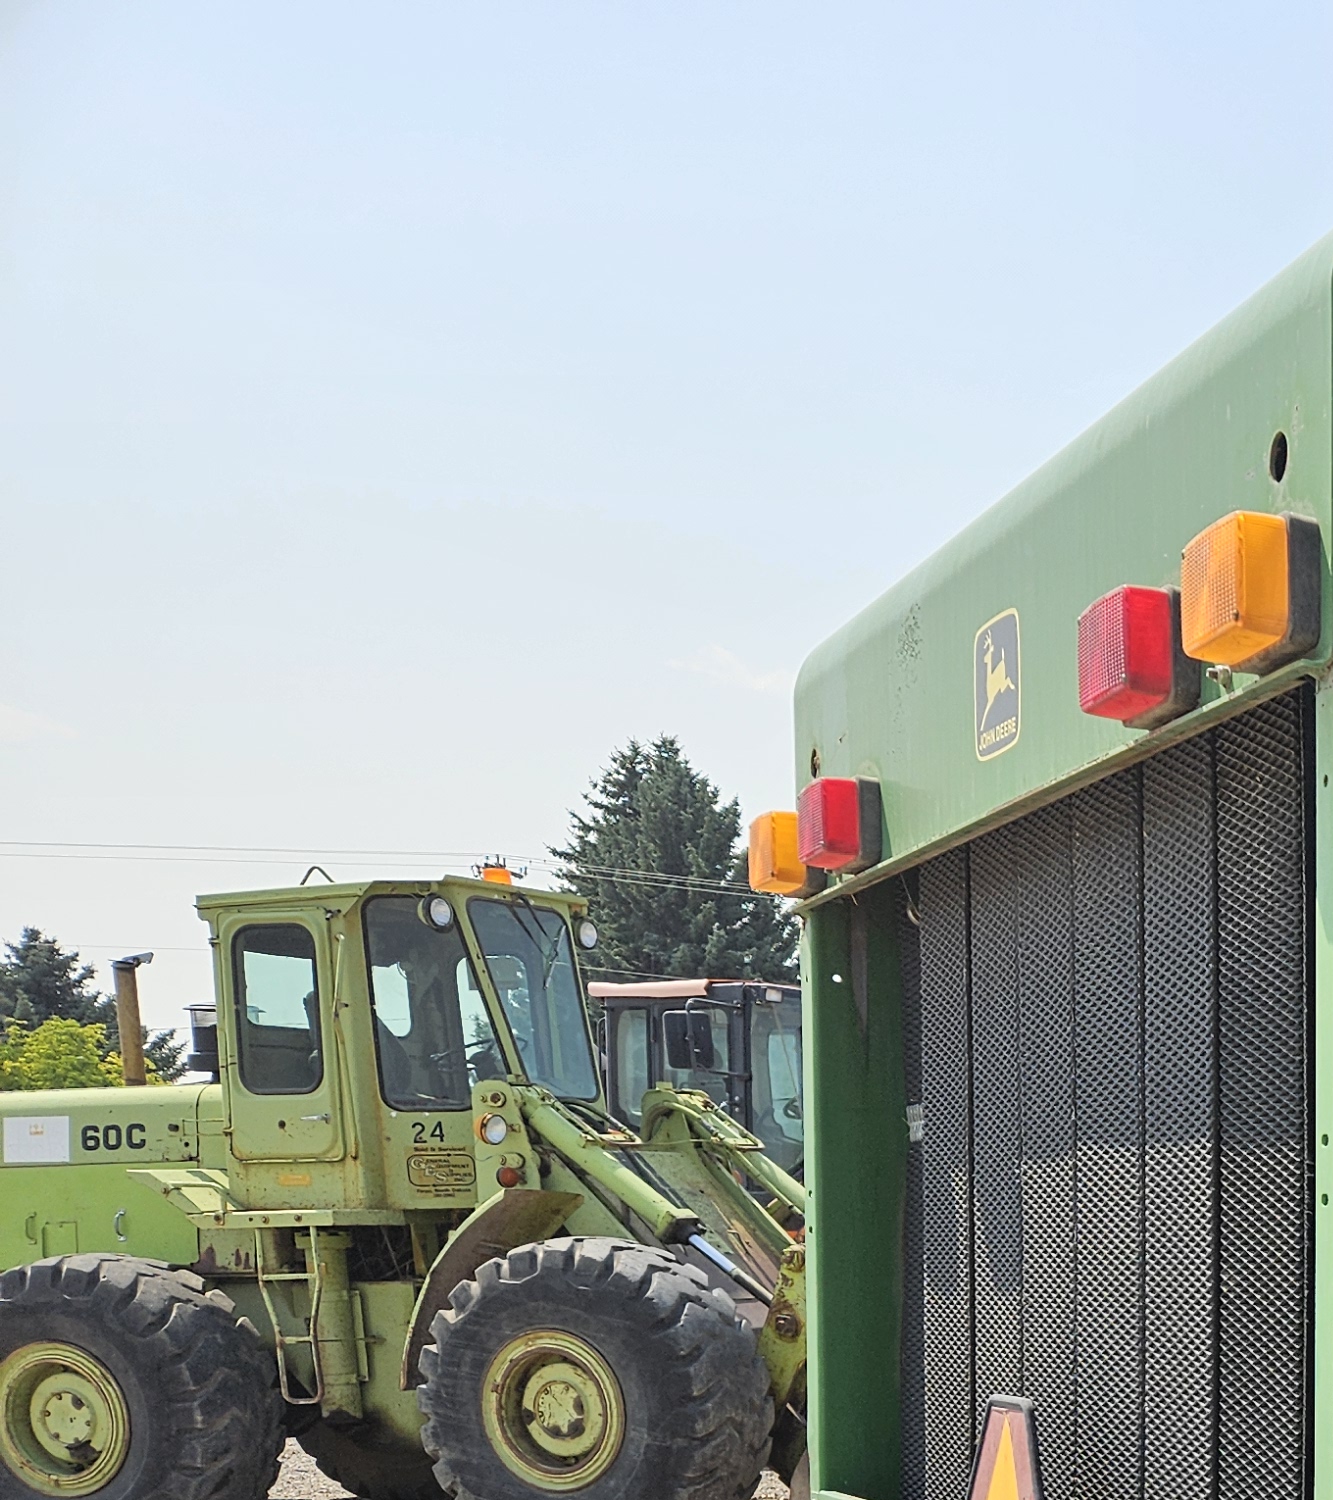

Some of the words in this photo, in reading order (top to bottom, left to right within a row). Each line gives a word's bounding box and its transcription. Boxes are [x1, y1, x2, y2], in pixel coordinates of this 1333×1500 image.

[979, 727, 996, 750] JOHN
[995, 716, 1016, 742] DEERE
[81, 1123, 146, 1151] 60C
[411, 1121, 445, 1144] 24
